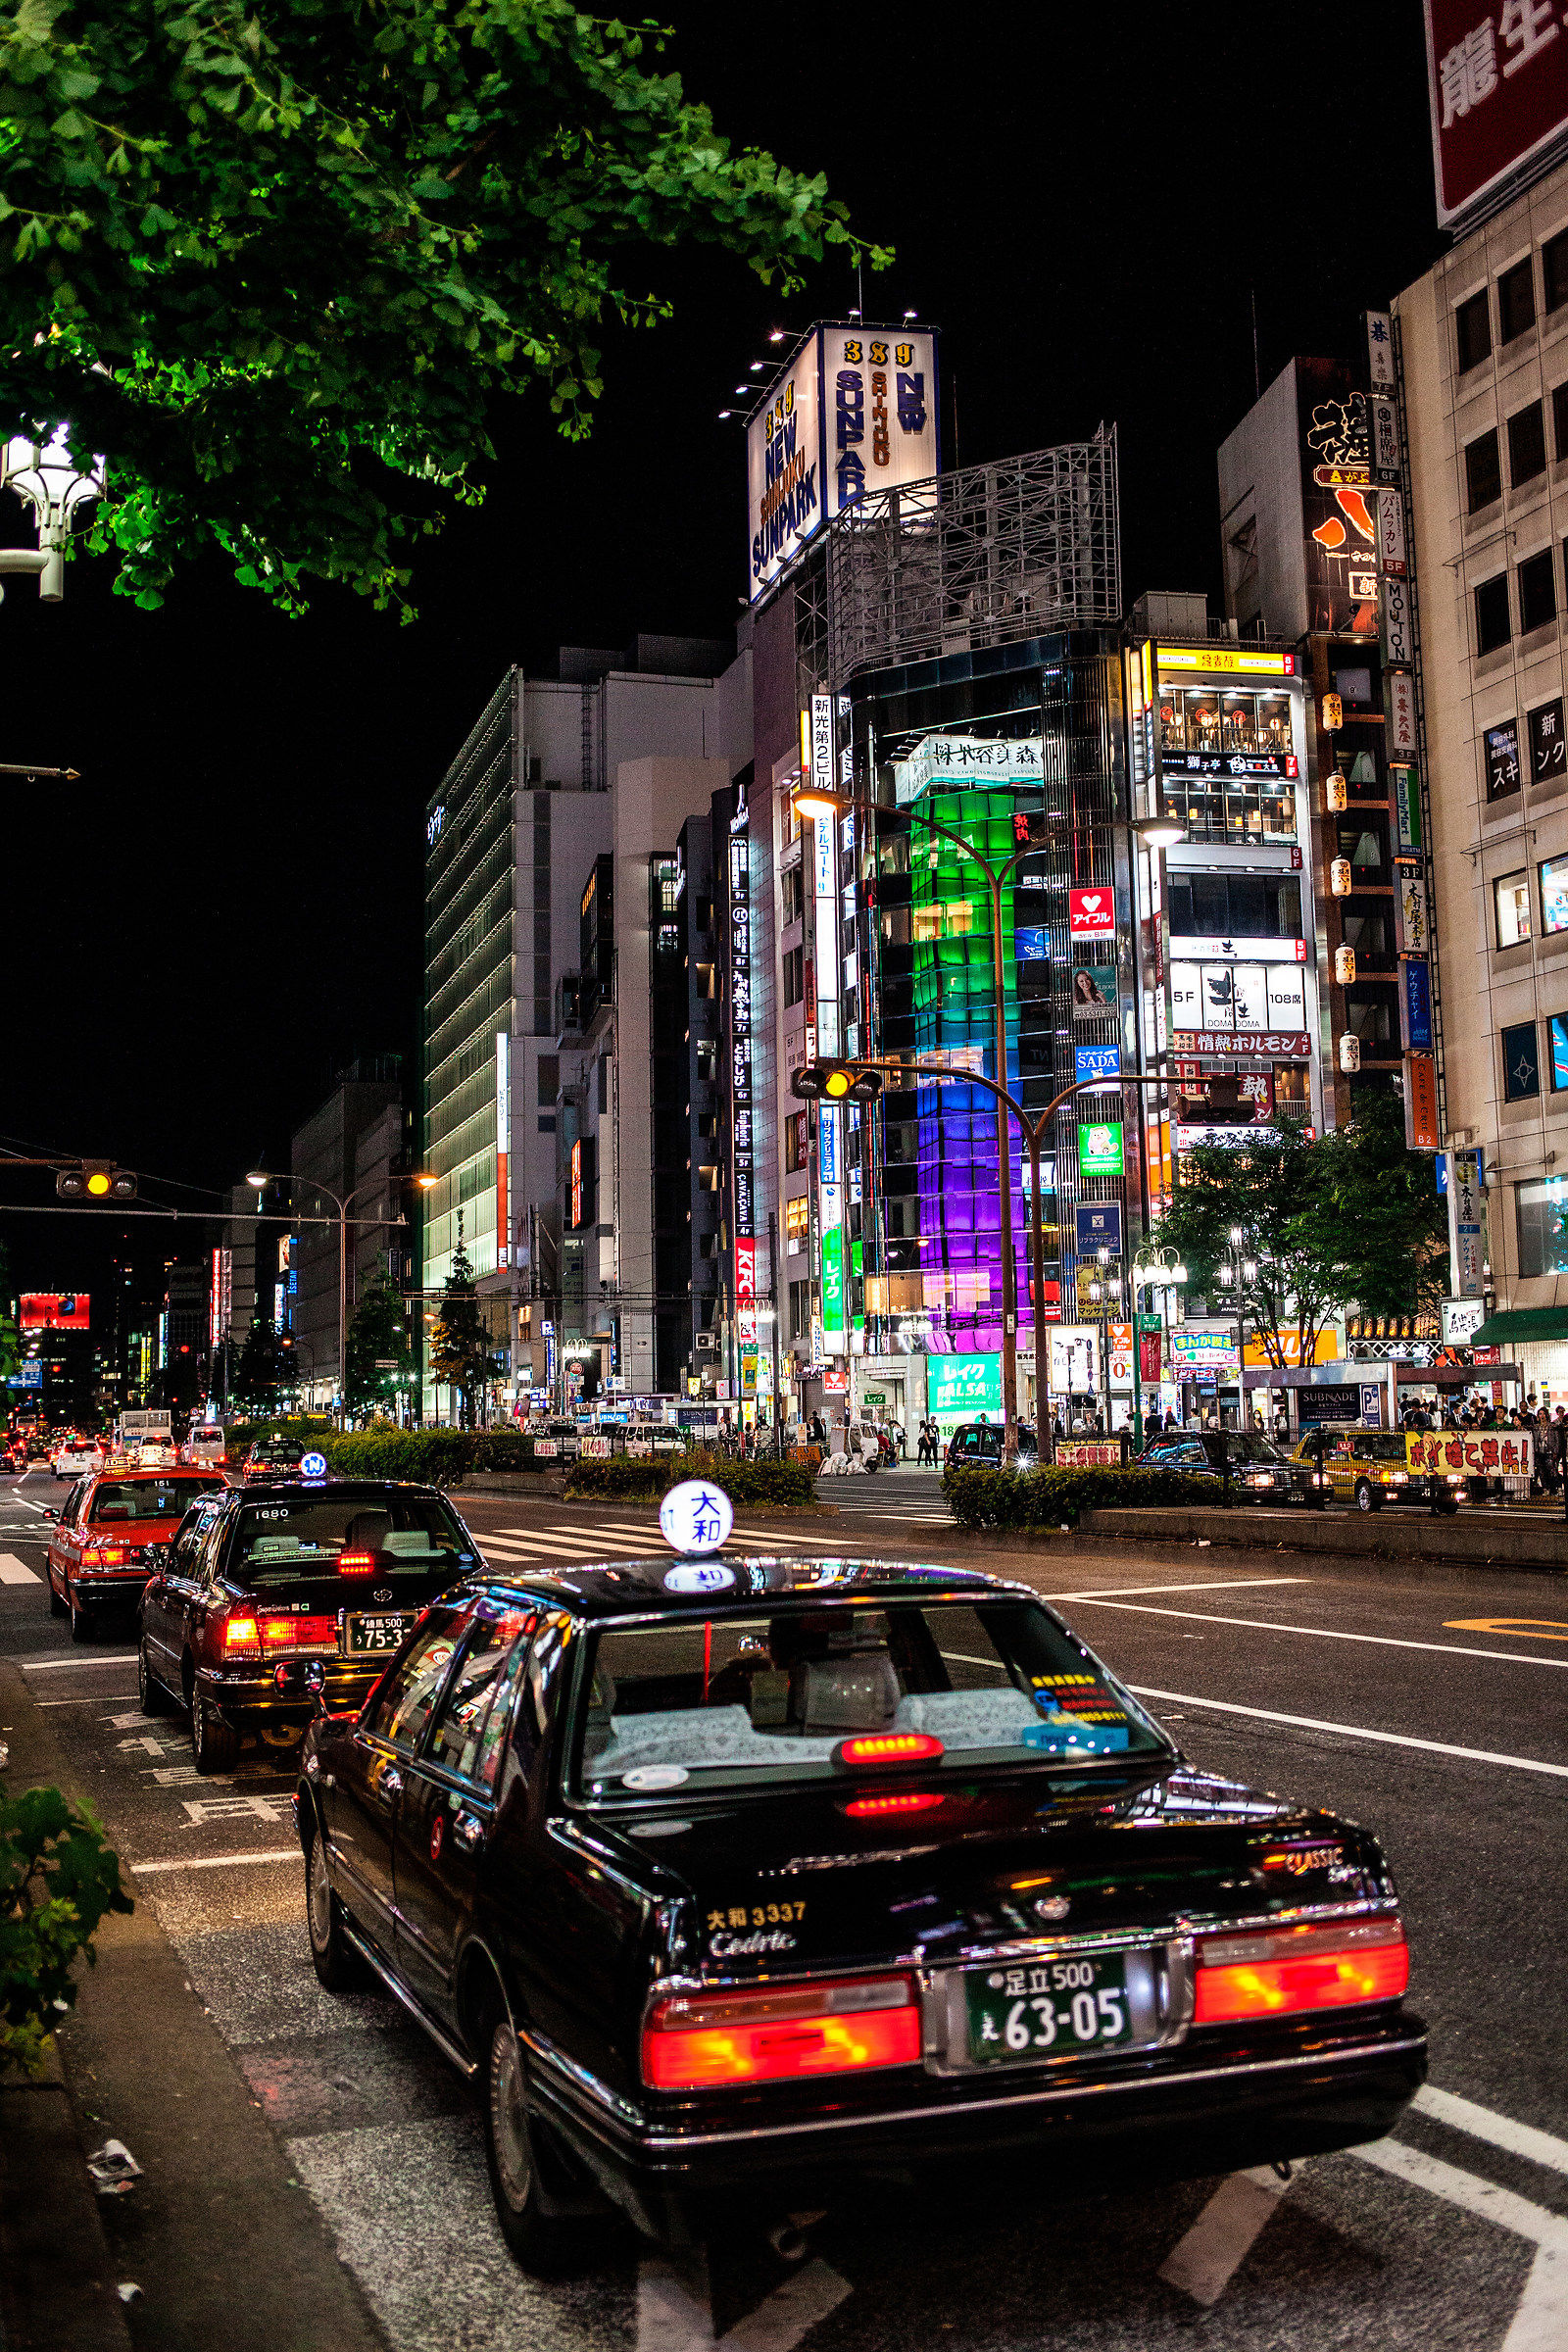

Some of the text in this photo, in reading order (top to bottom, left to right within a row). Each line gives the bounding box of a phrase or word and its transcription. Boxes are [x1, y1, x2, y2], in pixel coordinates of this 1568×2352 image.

[845, 340, 914, 368] 389
[897, 372, 927, 435] NEW
[765, 410, 797, 489] NEW
[1382, 471, 1395, 480] 6F
[753, 462, 816, 578] SUNPARK
[1382, 496, 1396, 554] パムッカレ
[1386, 561, 1402, 571] 5F
[1390, 584, 1404, 661] MOUTON
[1285, 657, 1292, 673] 8F
[1542, 712, 1556, 736] 新
[814, 700, 831, 790] 新光第2ビル
[1287, 757, 1296, 775] 7F
[1493, 741, 1564, 788] スキ ンク
[1397, 777, 1409, 835] FamilyMart
[1293, 849, 1299, 866] 6F
[1403, 867, 1420, 878] 3F
[1072, 912, 1111, 925] アイフル
[1297, 941, 1304, 959] 5F
[1173, 991, 1195, 1003] 5F
[1198, 1034, 1297, 1052] 情熱ホルモン
[1301, 1035, 1308, 1053] 4F
[1078, 1055, 1117, 1068] SADA
[1418, 1135, 1432, 1144] B2
[738, 1248, 754, 1298] KFC
[826, 1260, 840, 1298] レイク
[944, 1364, 985, 1381] レイク
[1303, 1392, 1355, 1402] SUBNADE
[309, 1459, 319, 1471] N
[256, 1508, 289, 1519] 1680
[691, 1491, 721, 1544] 大和
[366, 1618, 403, 1629] 練馬 500
[365, 1629, 411, 1648] 75-3
[707, 1901, 807, 1931] 大和 3337
[1004, 1962, 1094, 1996] 足立 500
[1004, 1986, 1124, 2050] 63-05
